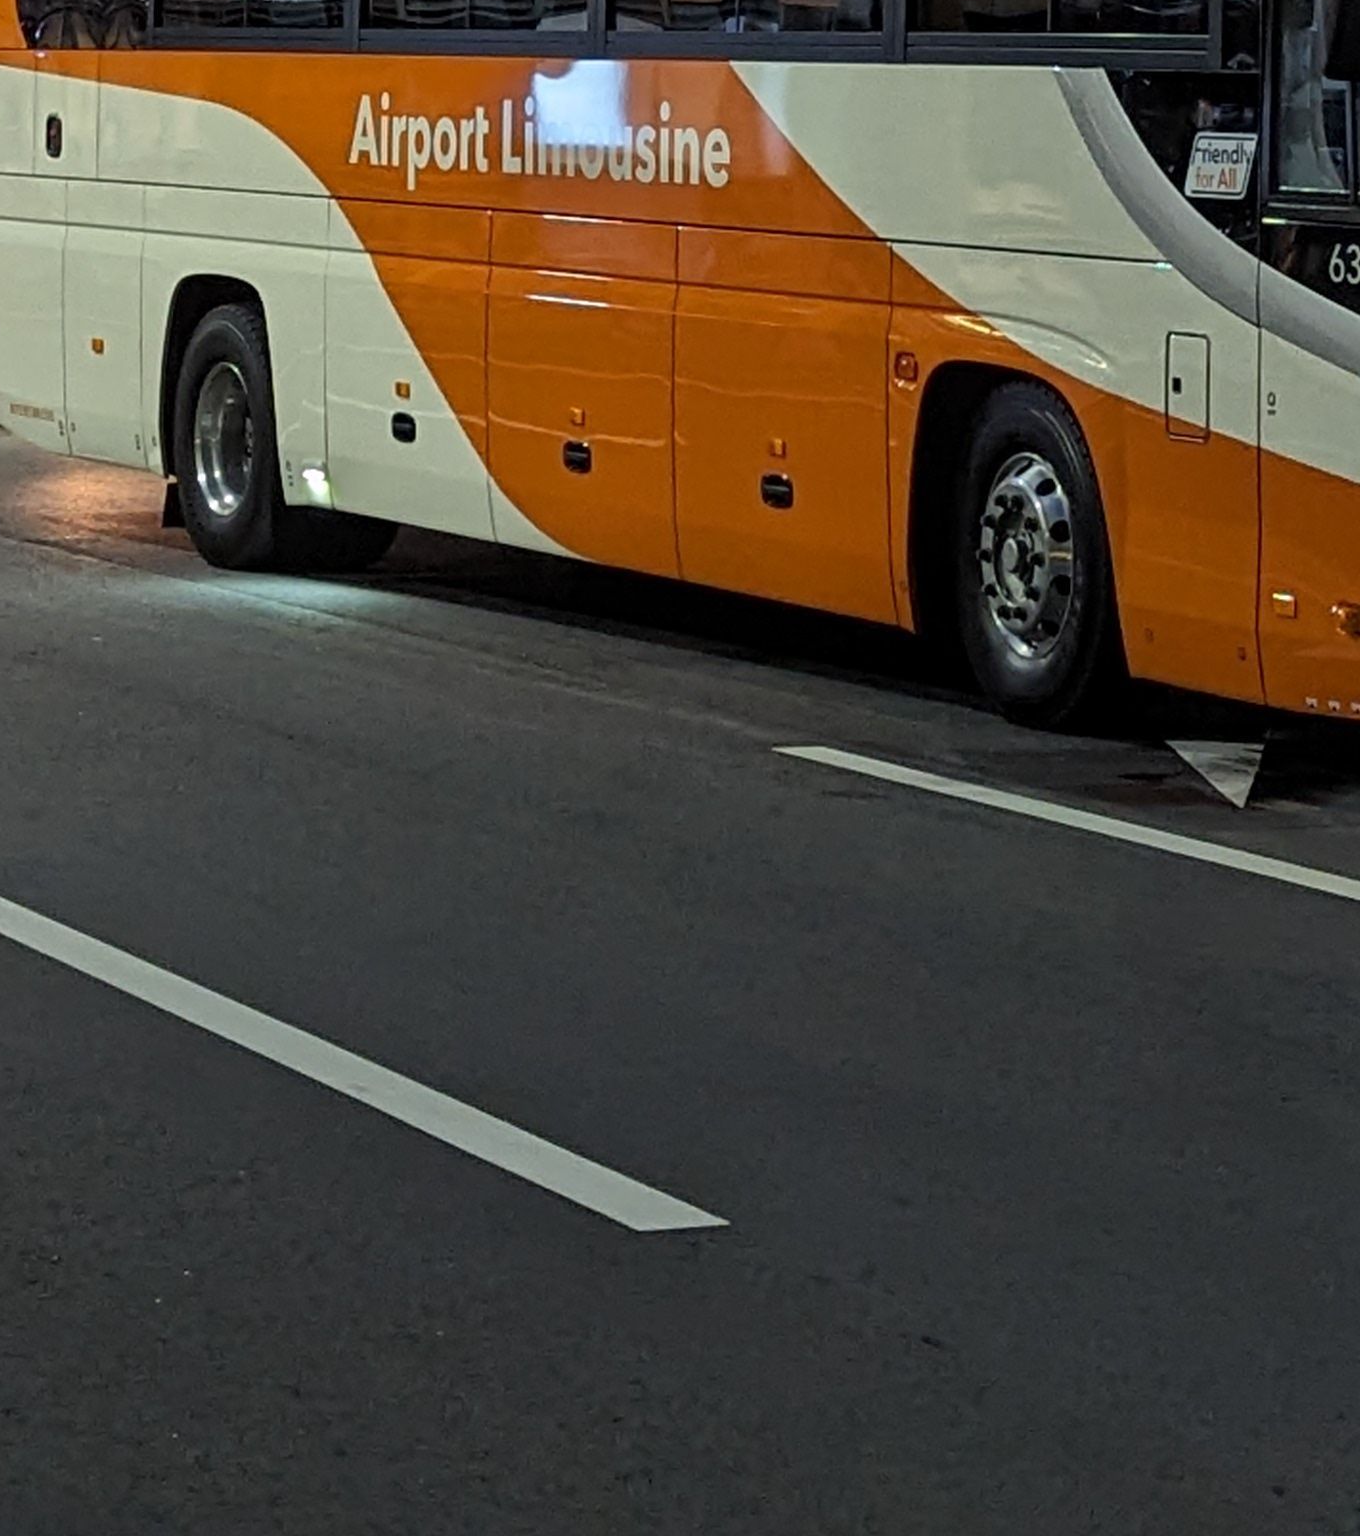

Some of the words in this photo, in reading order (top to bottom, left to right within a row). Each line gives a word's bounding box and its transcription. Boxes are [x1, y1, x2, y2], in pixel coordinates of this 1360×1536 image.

[348, 91, 490, 191] Airport
[501, 96, 731, 189] Limousine
[1195, 166, 1215, 188] for
[1217, 167, 1238, 189] All
